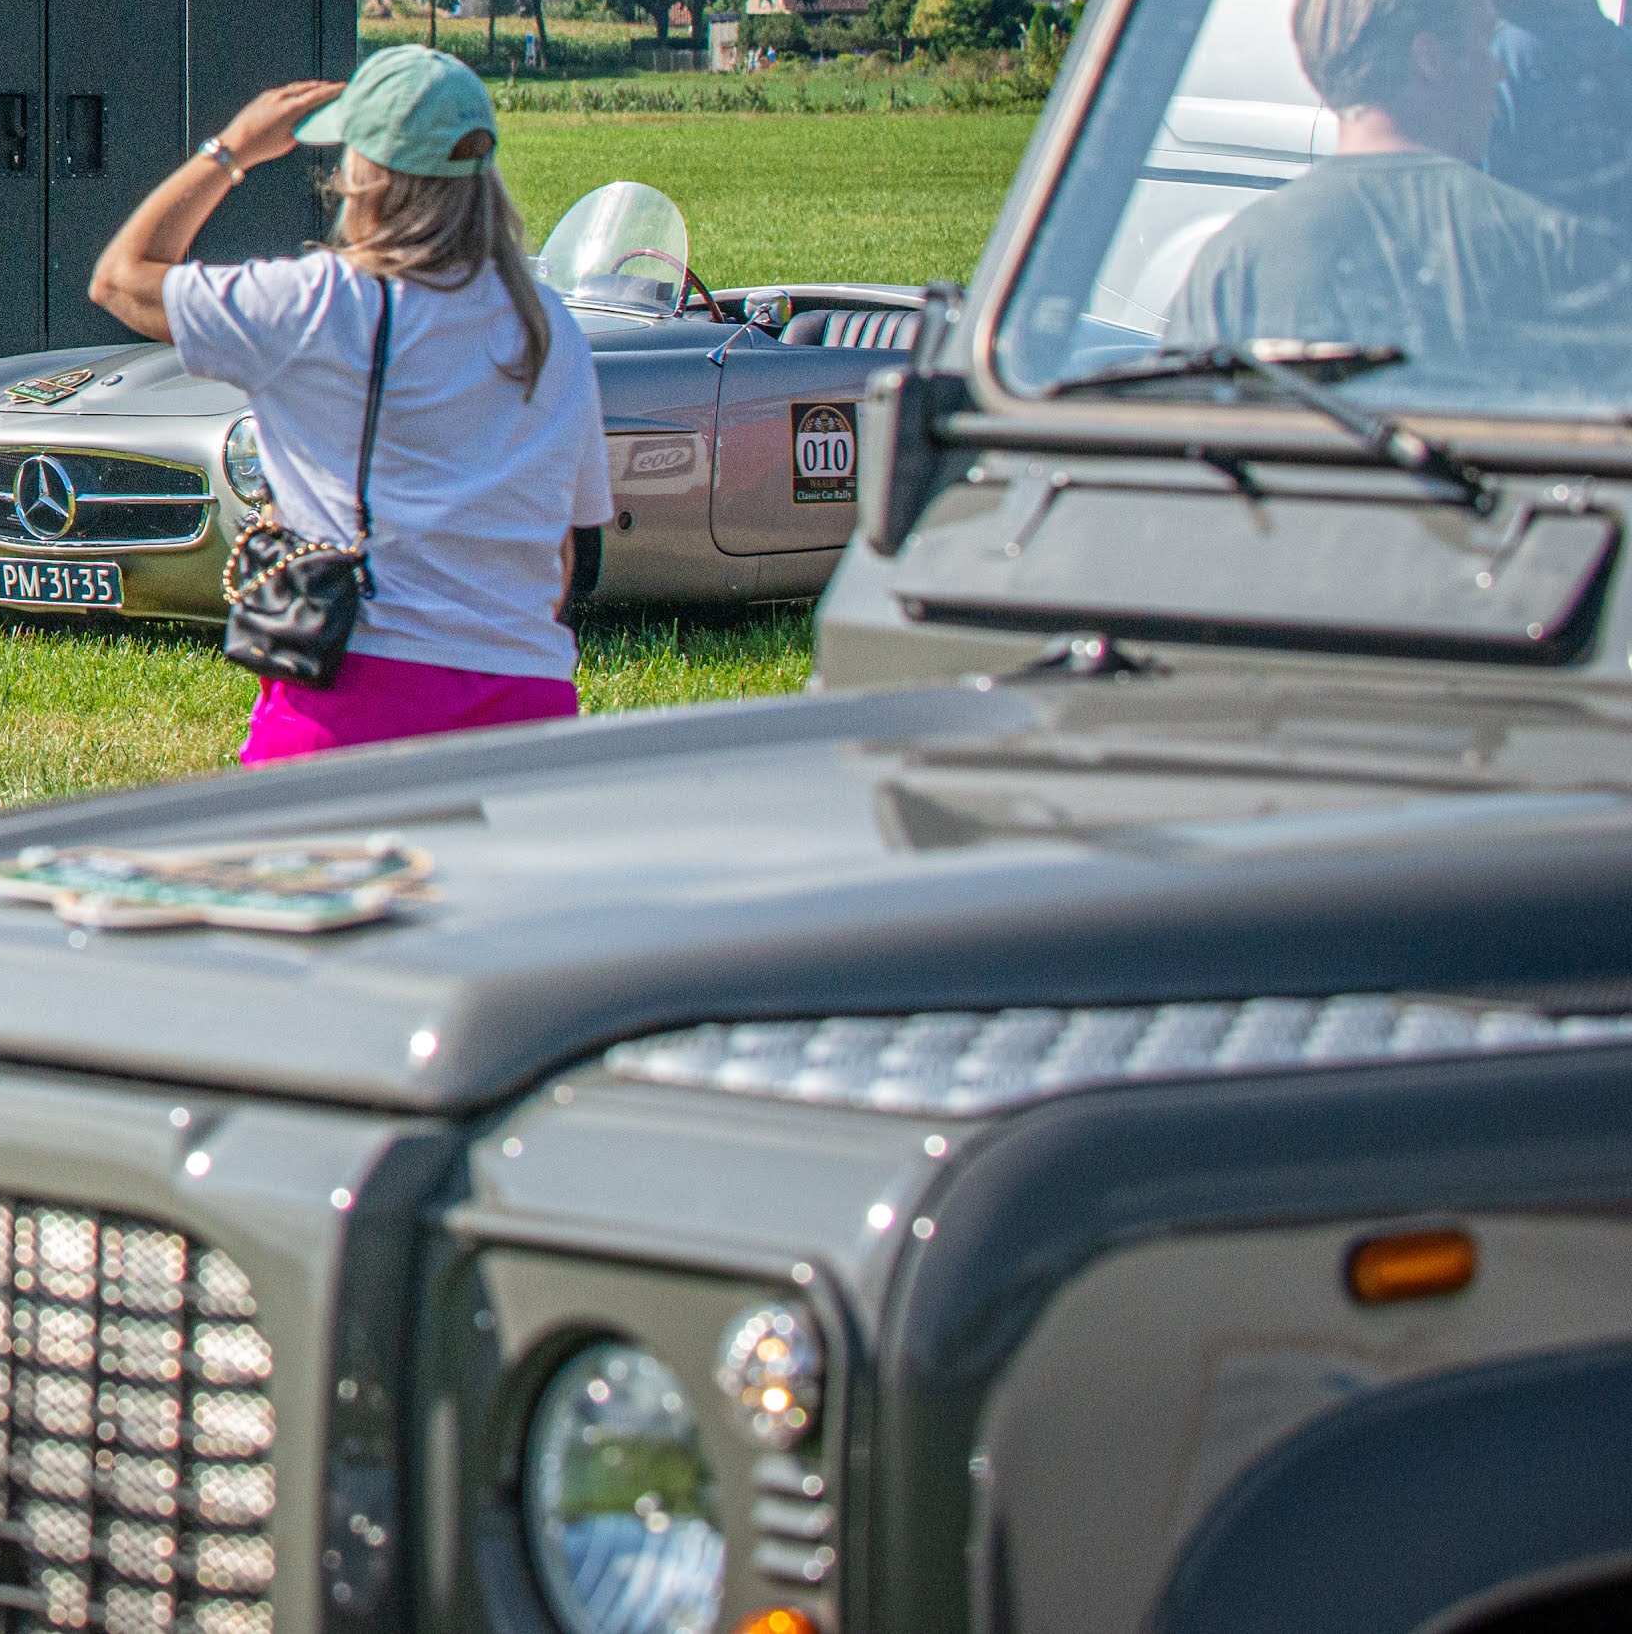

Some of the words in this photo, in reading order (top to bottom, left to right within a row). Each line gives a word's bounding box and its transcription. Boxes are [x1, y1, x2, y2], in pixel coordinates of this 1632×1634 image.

[803, 439, 847, 471] 010
[797, 490, 820, 500] Classic
[822, 490, 833, 499] Car
[835, 490, 852, 500] Rally
[3, 565, 113, 601] PM-31-35
